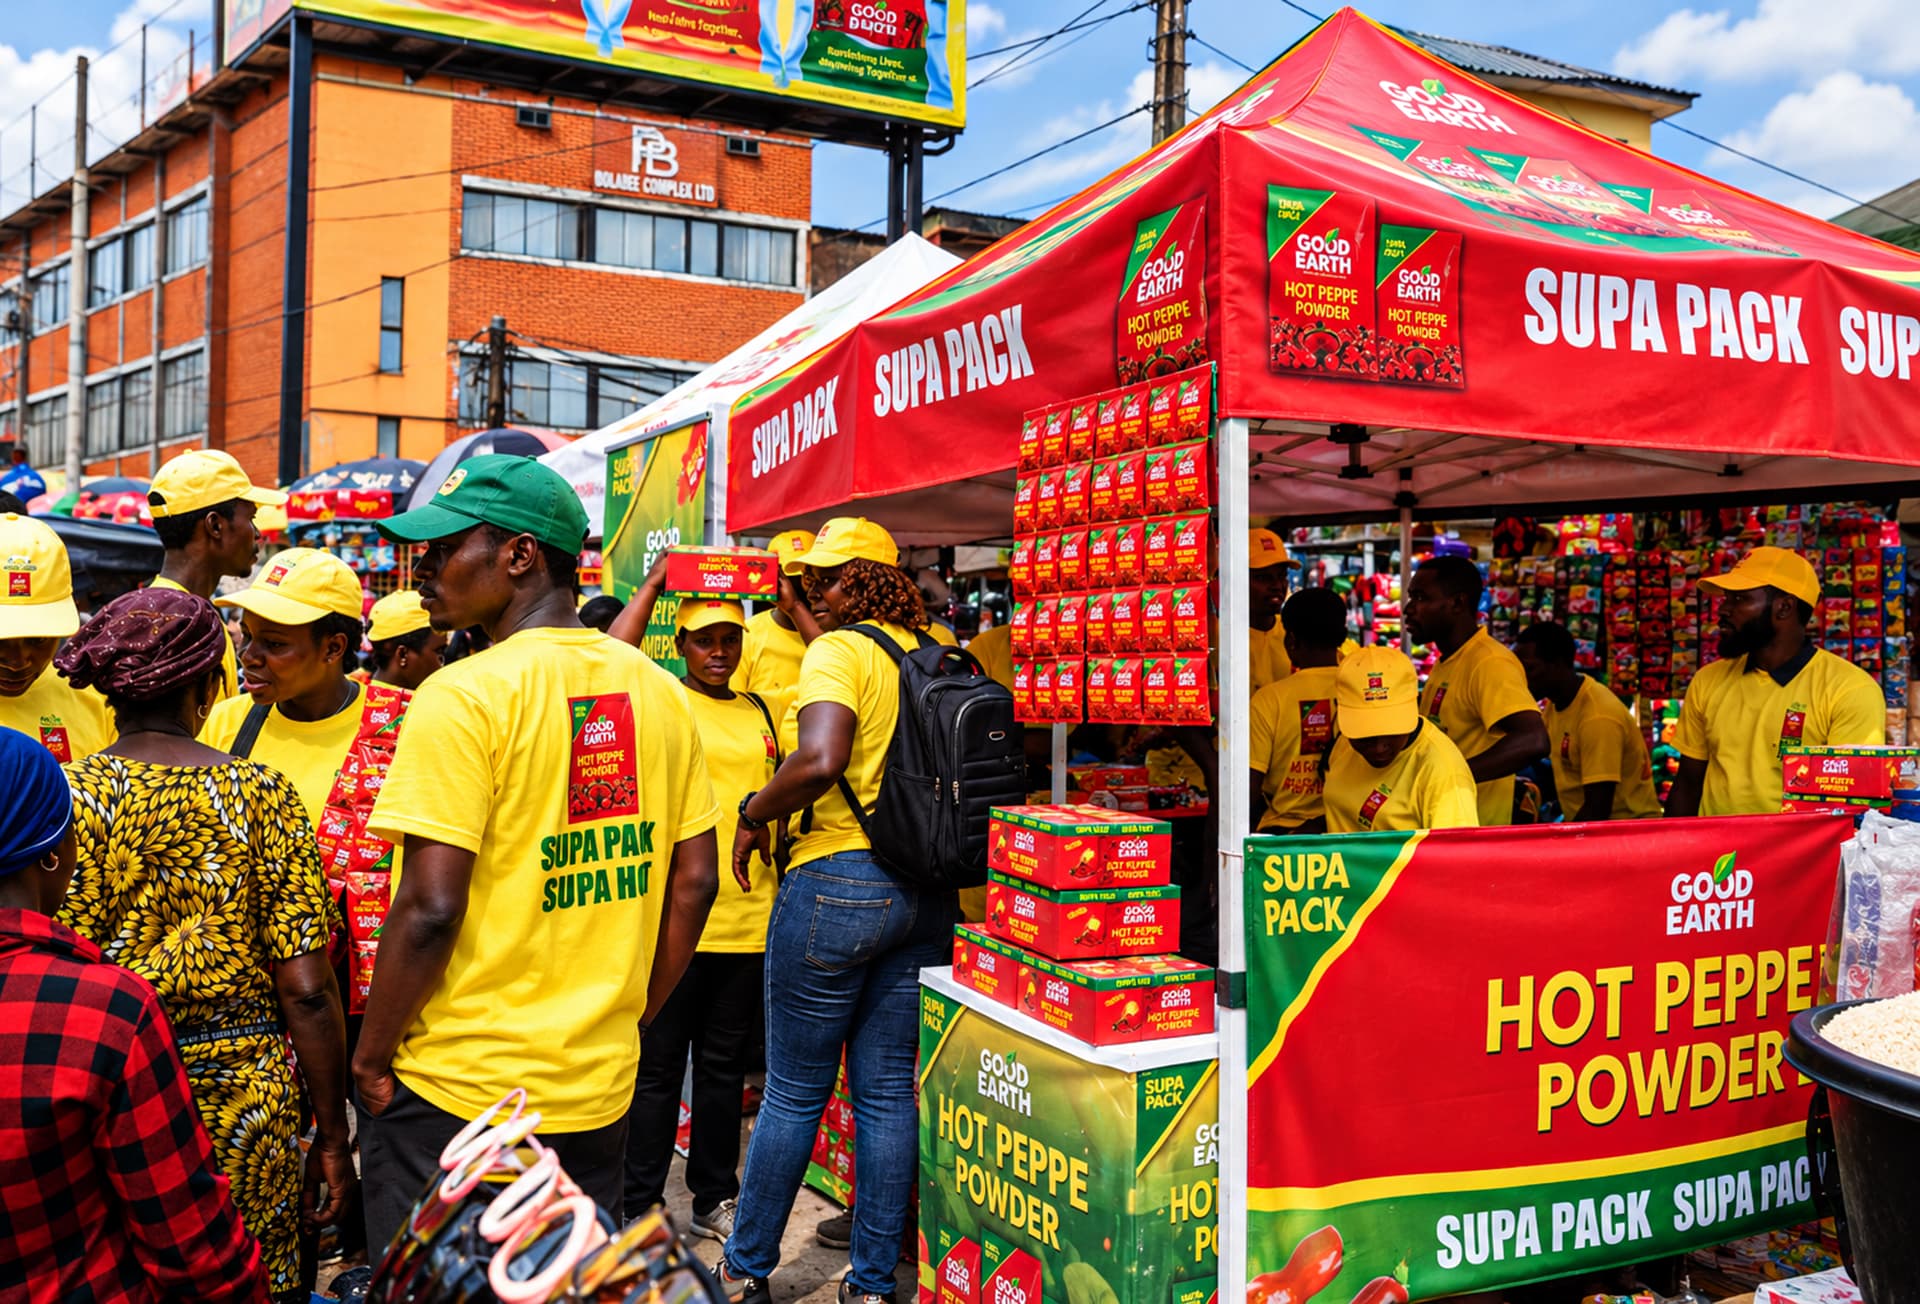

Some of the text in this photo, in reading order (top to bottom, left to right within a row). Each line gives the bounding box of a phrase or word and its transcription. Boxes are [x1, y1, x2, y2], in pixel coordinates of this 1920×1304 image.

[851, 3, 897, 23] GOOD
[1379, 80, 1486, 113] GOOD
[1391, 99, 1518, 135] EARTH
[1297, 234, 1350, 255] GOOD
[1142, 251, 1185, 281] GOOD
[1295, 251, 1352, 275] EARTH
[1398, 269, 1440, 287] GOOD
[1136, 269, 1184, 303] EARTH
[1284, 281, 1358, 305] HOT PEPPE
[1397, 283, 1440, 302] EARTH
[1127, 300, 1191, 334] HOT PEPPE
[1295, 301, 1350, 320] POWDER
[1388, 308, 1447, 327] HOT PEPPE
[1524, 267, 1810, 365] SUPA PACK
[1136, 324, 1183, 350] POWDER
[874, 337, 945, 418] SUPA
[943, 304, 1035, 397] PACK
[752, 375, 839, 479] SUPA PACK
[646, 527, 680, 552] GOOD
[583, 731, 616, 746] EARTH
[541, 828, 600, 872] SUPA
[1262, 851, 1350, 893] SUPA
[1671, 869, 1753, 904] GOOD
[542, 869, 612, 913] SUPA
[1264, 896, 1347, 937] PACK
[1666, 899, 1754, 936] EARTH
[1486, 944, 1838, 1054] HOT PEPPE
[980, 1048, 1029, 1088] GOOD
[1145, 1075, 1185, 1095] SUPA
[1537, 1030, 1786, 1134] POWDER
[978, 1070, 1032, 1117] EARTH
[1145, 1092, 1183, 1110] PACK
[1195, 1123, 1219, 1145] GO
[938, 1092, 1089, 1214] HOT PEPPE
[955, 1155, 1061, 1252] POWDER
[1437, 1205, 1543, 1269] SUPA
[1552, 1189, 1654, 1252] PACK
[1673, 1170, 1755, 1232] SUPA
